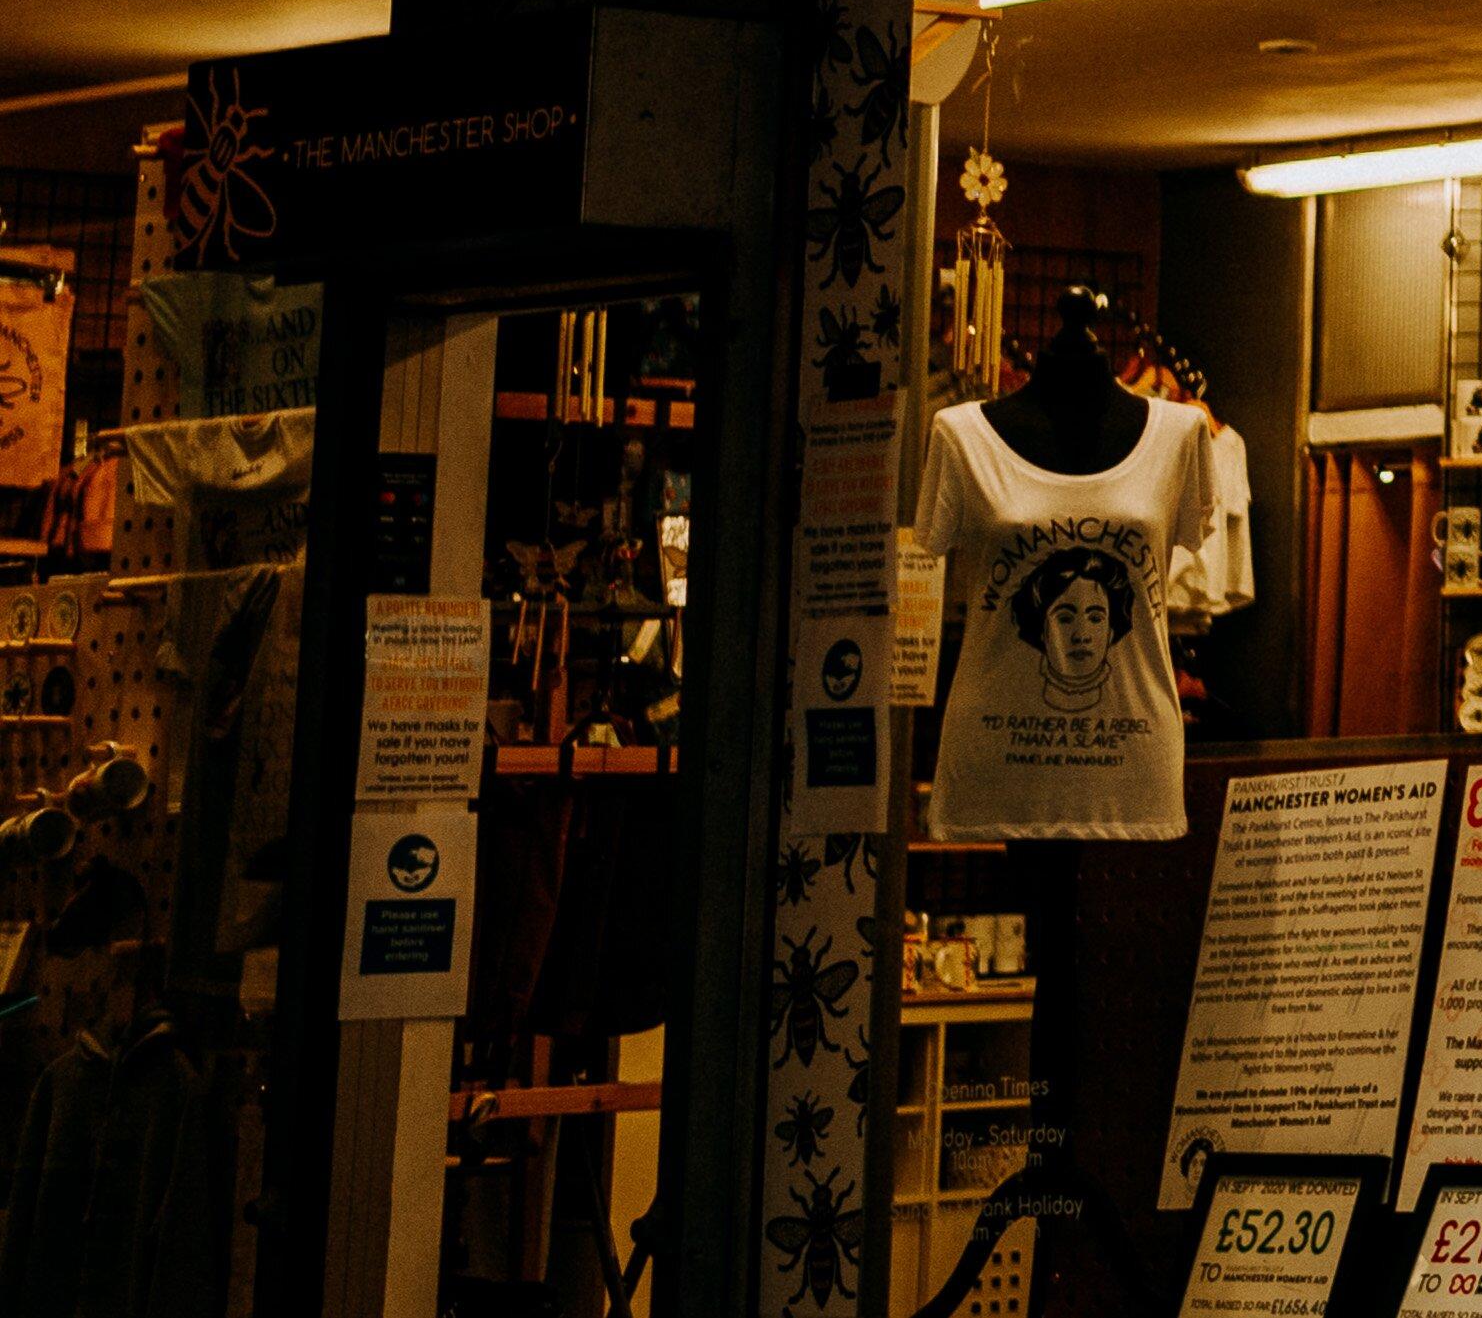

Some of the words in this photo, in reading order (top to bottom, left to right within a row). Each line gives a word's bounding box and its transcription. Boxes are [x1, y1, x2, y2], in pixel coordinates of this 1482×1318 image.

[293, 136, 335, 170] THE
[340, 115, 495, 165] MANCHESTER
[502, 104, 565, 143] SHOP
[1006, 716, 1066, 732] RATHER
[1069, 716, 1090, 731] BE
[1095, 717, 1105, 732] A
[1108, 717, 1152, 734] REBEL
[1009, 731, 1058, 747] THAN
[1058, 731, 1068, 746] A
[1230, 790, 1330, 814] MANCHESTER
[1334, 783, 1406, 805] WOMEN'S
[1408, 781, 1438, 799] AID
[1445, 1036, 1464, 1049] The
[1000, 1076, 1050, 1097] Times
[988, 1122, 1067, 1146] Saturday
[1261, 1182, 1285, 1195] 2020
[1288, 1182, 1304, 1195] WE
[1305, 1182, 1358, 1196] DONATED
[1440, 1191, 1452, 1204] IN
[1018, 1195, 1084, 1222] Holiday
[1215, 1208, 1335, 1255] £52.30
[1199, 1262, 1222, 1284] TO
[1417, 1273, 1442, 1294] TO
